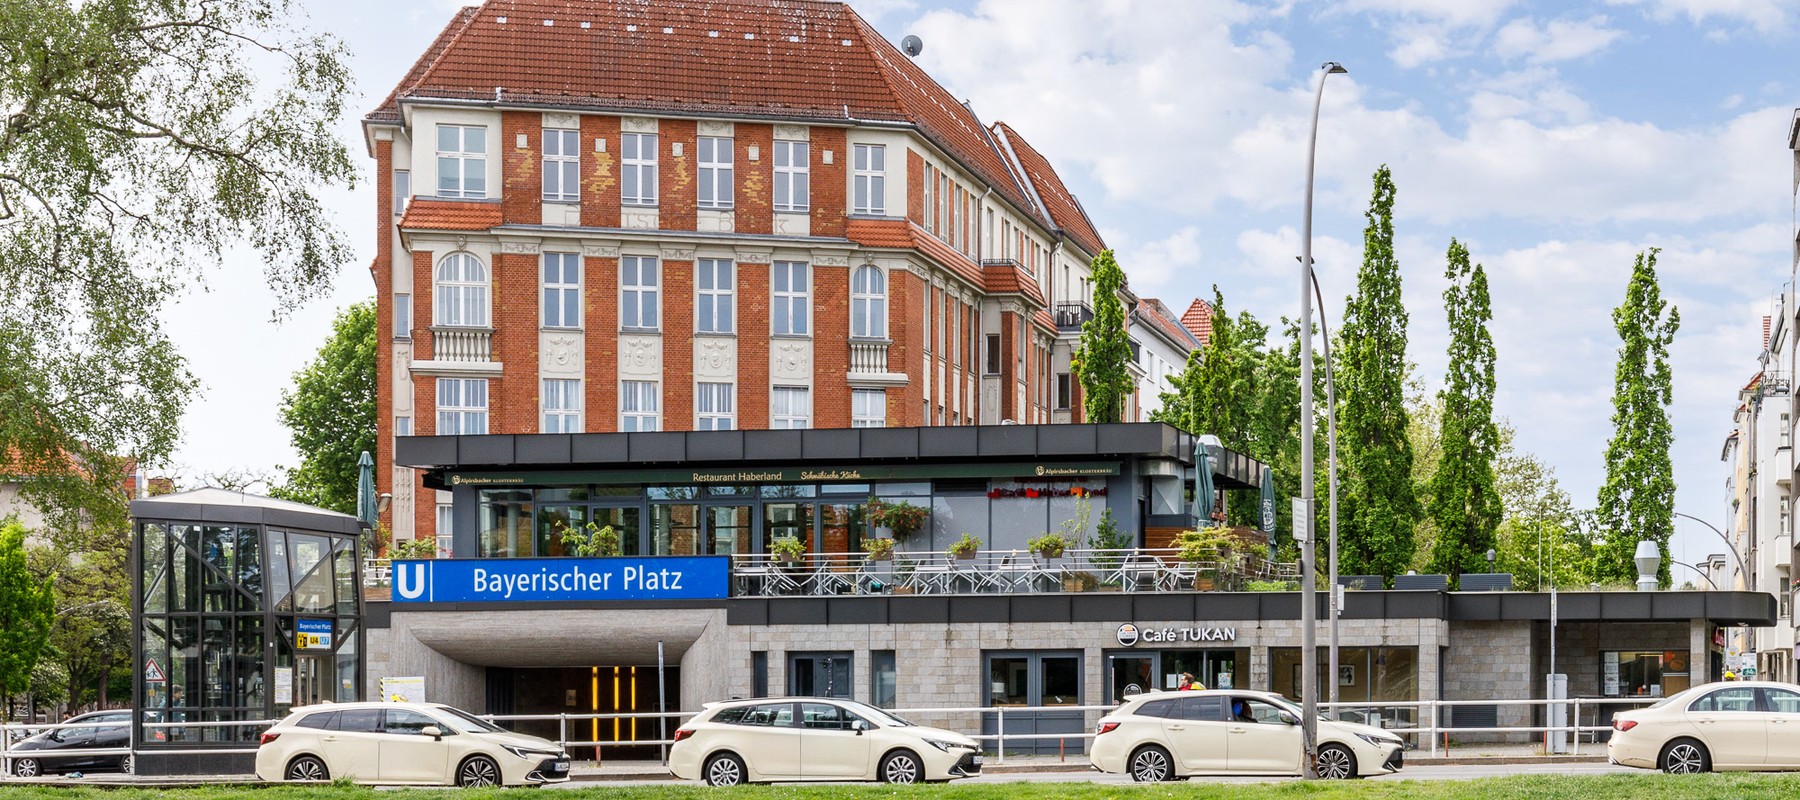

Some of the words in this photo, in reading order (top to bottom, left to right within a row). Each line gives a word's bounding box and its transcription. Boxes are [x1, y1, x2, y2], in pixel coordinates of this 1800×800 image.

[693, 473, 736, 482] Restaurant
[738, 471, 782, 481] Haberland
[800, 470, 839, 480] Schwäbische
[839, 469, 861, 479] Küche
[397, 564, 425, 598] U
[474, 566, 612, 598] Bayerischer
[623, 565, 682, 591] Platz
[310, 636, 319, 644] U4
[1142, 627, 1177, 642] Café
[1180, 627, 1236, 641] TUKAN
